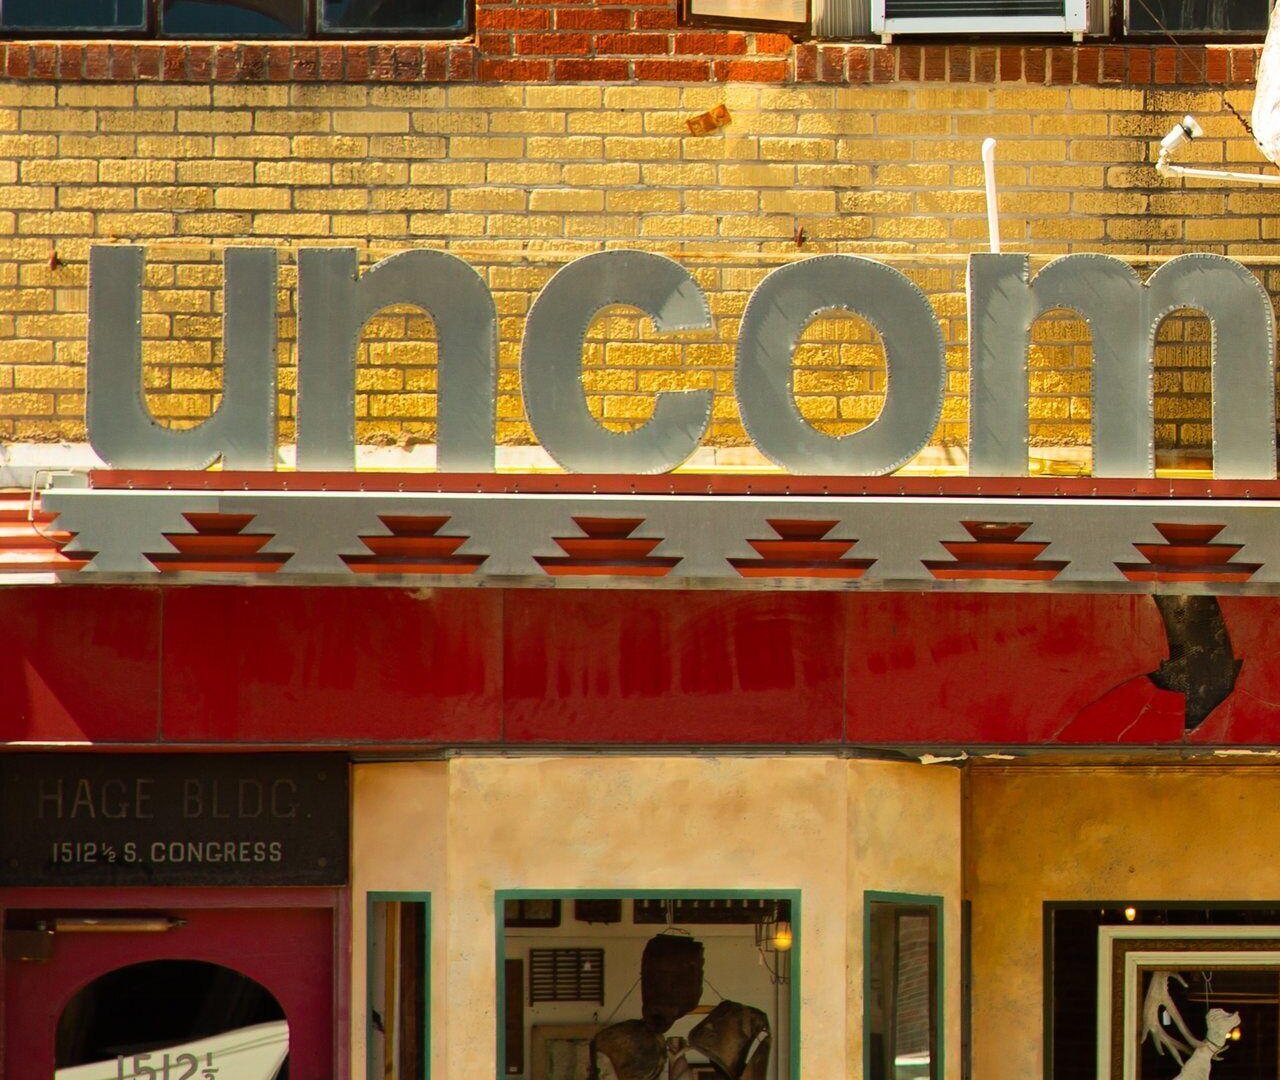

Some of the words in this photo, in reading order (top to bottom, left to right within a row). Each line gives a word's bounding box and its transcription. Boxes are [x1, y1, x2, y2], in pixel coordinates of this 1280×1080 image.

[38, 778, 155, 819] HAGE
[182, 778, 313, 819] BLDG.
[123, 842, 143, 863] S.
[150, 841, 282, 863] CONGRESS
